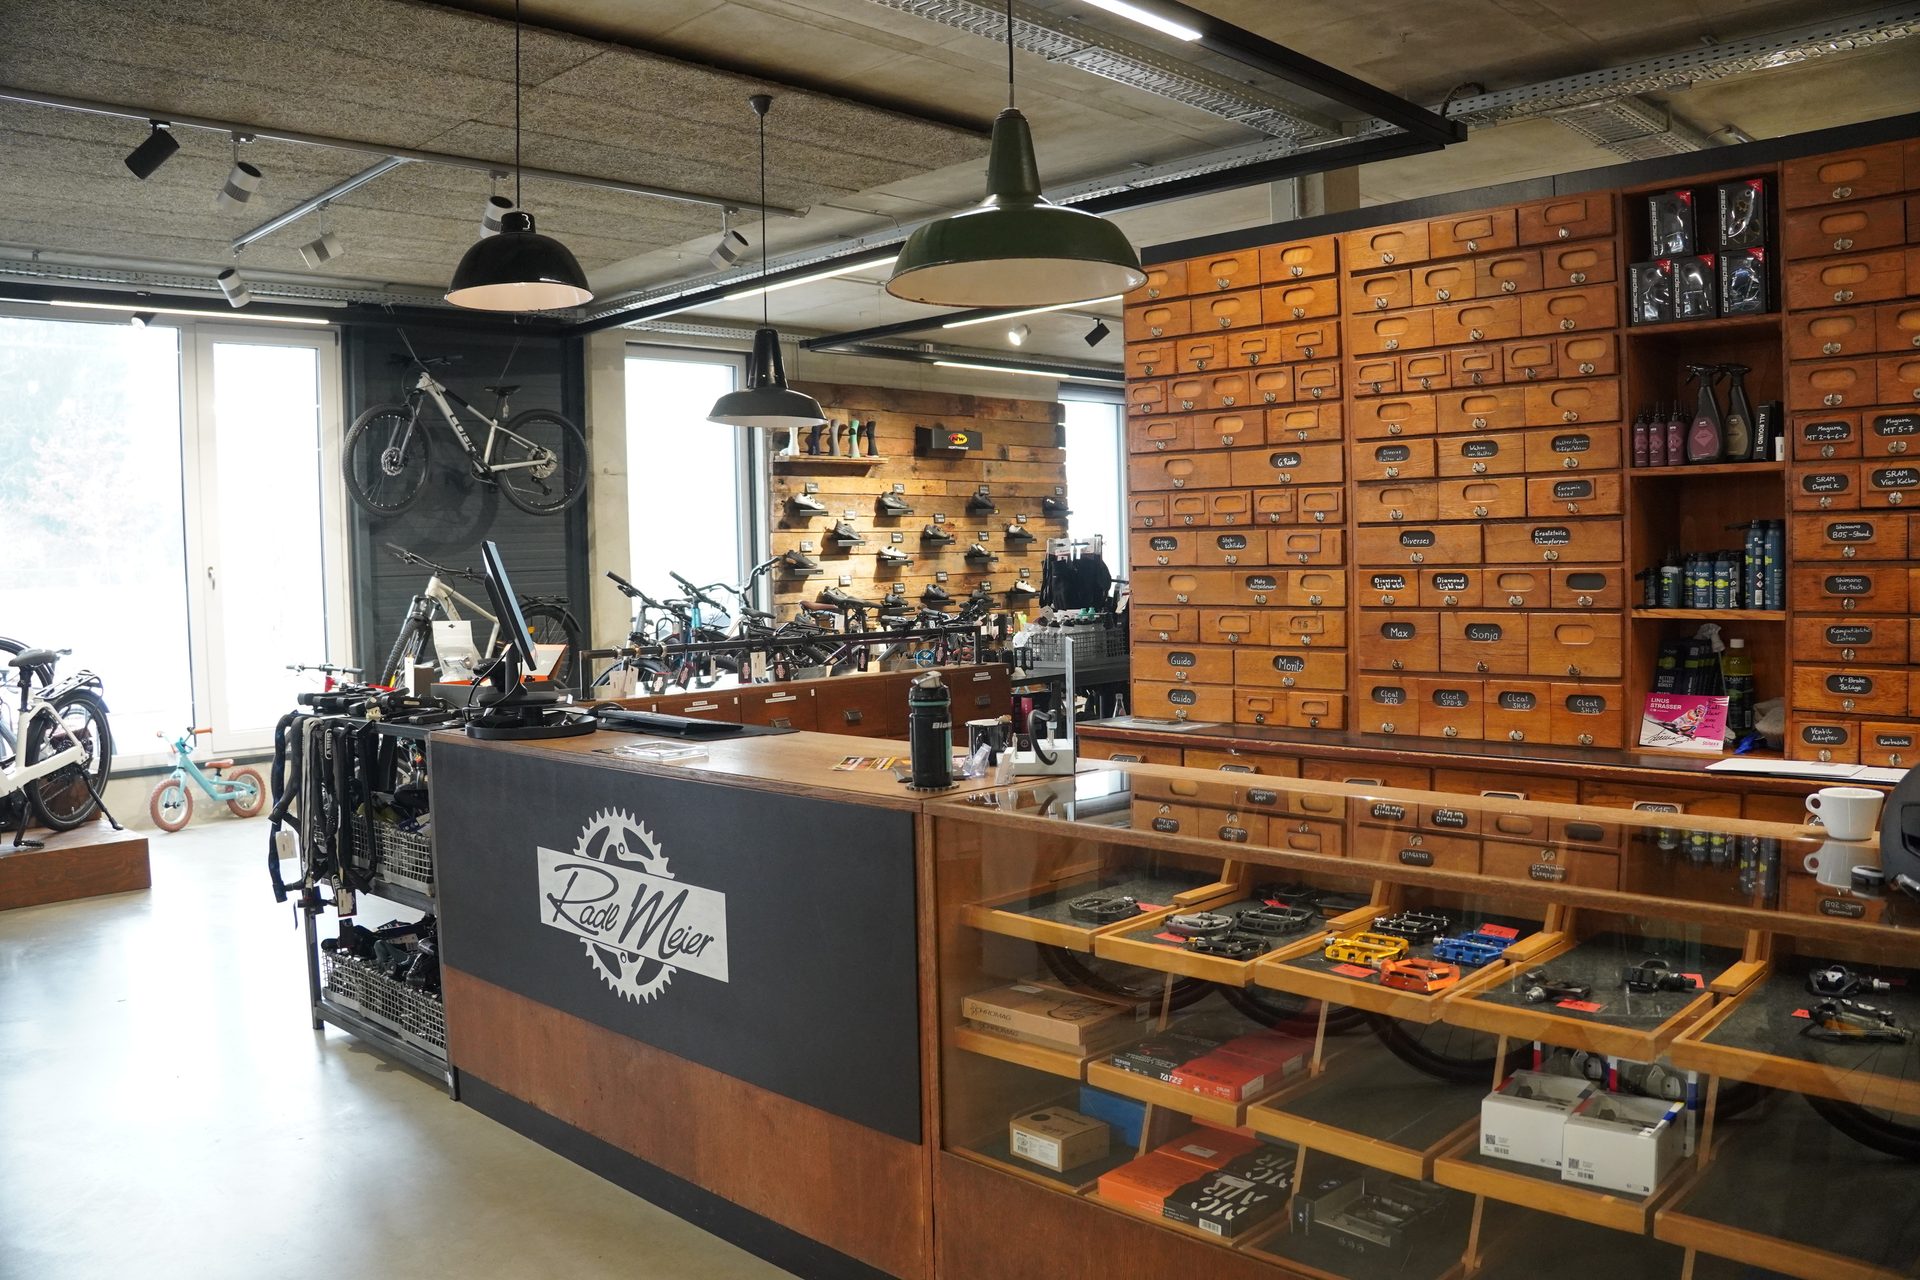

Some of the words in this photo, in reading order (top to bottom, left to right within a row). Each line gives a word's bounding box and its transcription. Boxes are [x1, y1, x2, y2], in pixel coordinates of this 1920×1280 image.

[1885, 418, 1912, 426] Magura
[1757, 424, 1765, 445] ROUND
[1885, 470, 1908, 478] SRAM
[1402, 536, 1430, 545] Diverses
[1376, 582, 1391, 590] Light
[1439, 582, 1454, 590] Light
[1390, 627, 1408, 638] Max
[1471, 628, 1498, 641] Sonja
[1170, 655, 1192, 666] Guido
[1278, 658, 1304, 672] Moritz
[1170, 692, 1192, 704] Guido
[1380, 690, 1399, 698] Cleat
[1440, 692, 1460, 700] Cleat
[1507, 693, 1529, 702] Cleat
[1576, 698, 1598, 707] Cleat
[1650, 702, 1682, 711] STRASSER
[1811, 734, 1839, 742] Adapter
[547, 864, 620, 936] Radl
[618, 883, 714, 959] Meier
[974, 1006, 1012, 1021] CHROMAG
[1160, 1072, 1183, 1085] TATZE
